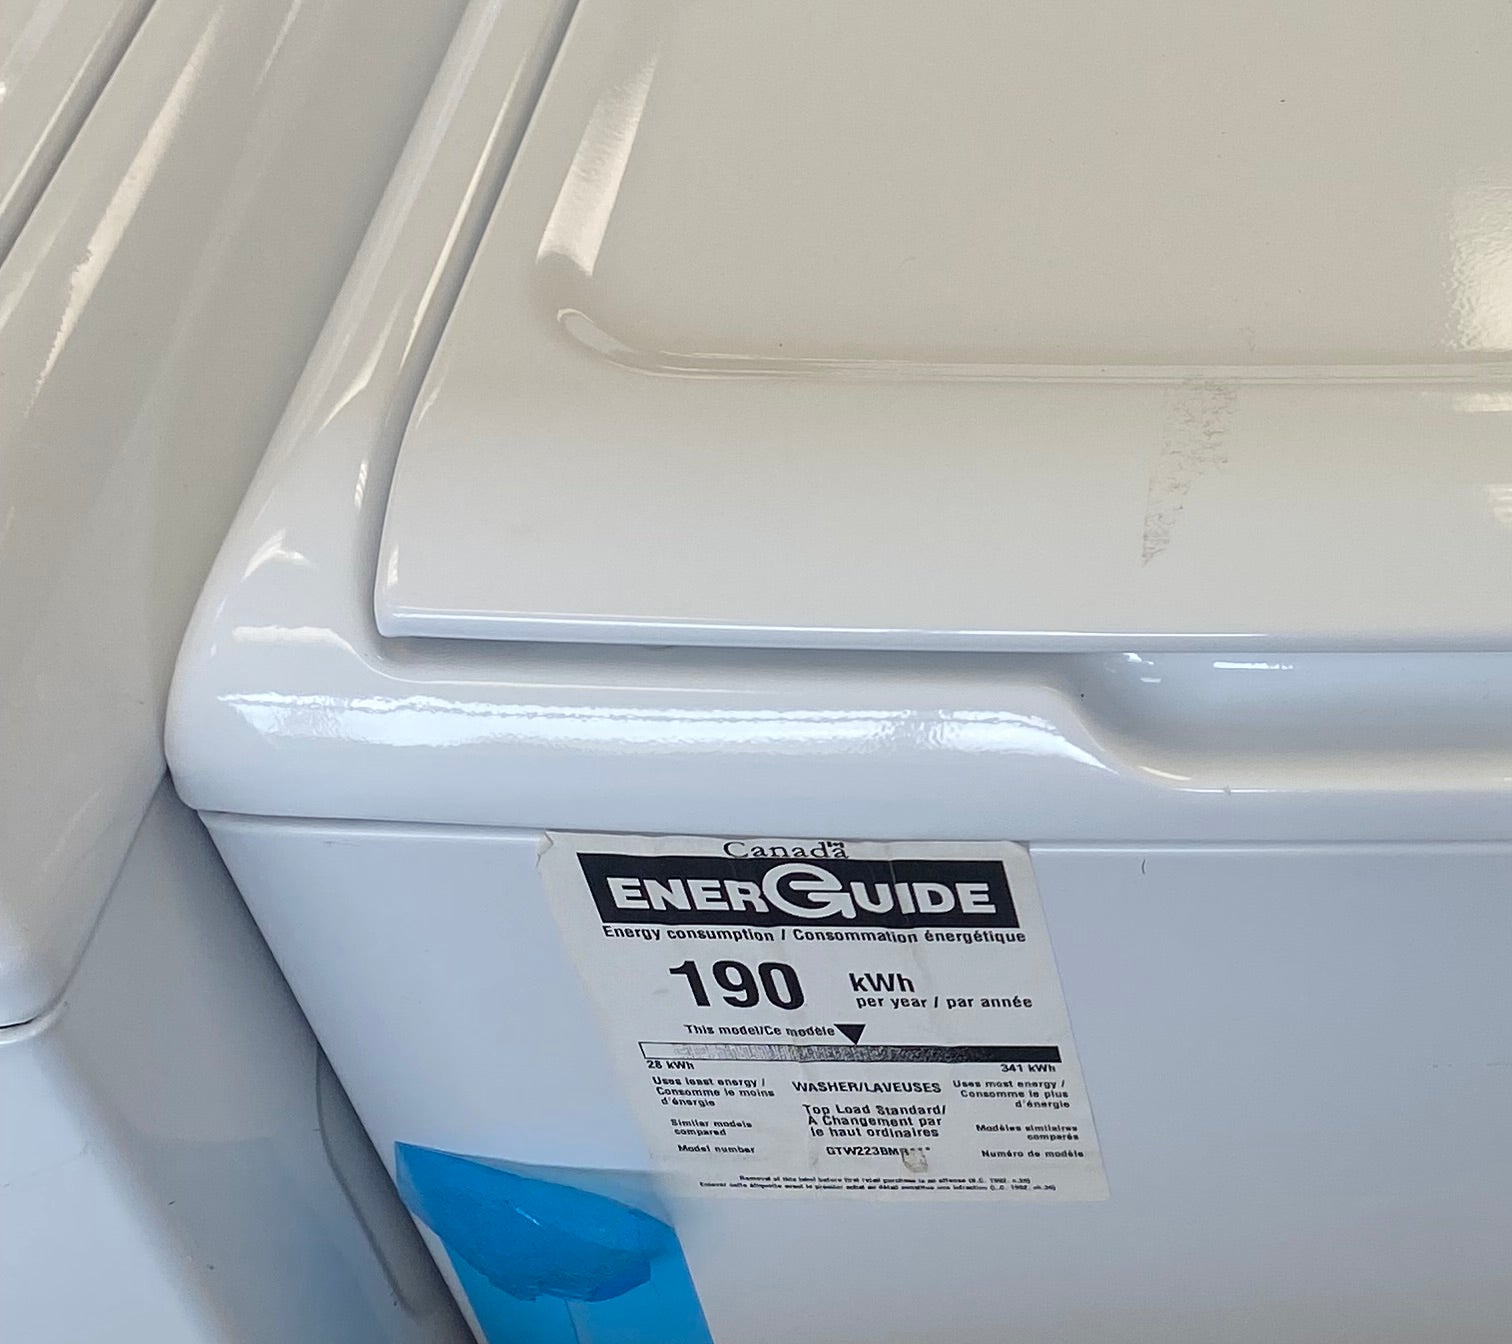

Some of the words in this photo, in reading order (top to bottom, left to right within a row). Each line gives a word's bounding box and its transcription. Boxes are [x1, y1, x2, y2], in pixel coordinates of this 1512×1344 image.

[723, 841, 849, 859] Canada
[606, 863, 997, 919] ENERGUIDE
[603, 925, 661, 941] Energy
[667, 927, 775, 943] consumption
[793, 928, 918, 944] Consommation
[925, 928, 1027, 944] énergétique
[669, 959, 805, 1011] 190
[849, 972, 916, 993] kWh
[856, 997, 883, 1009] per
[890, 997, 928, 1009] year
[946, 997, 974, 1010] par
[980, 994, 1033, 1008] année
[683, 1024, 715, 1035] This
[719, 1025, 782, 1037] model/Ce
[785, 1025, 836, 1038] modèle
[647, 1060, 663, 1069] 28
[667, 1060, 695, 1070] kWh
[1000, 1064, 1024, 1073] 341
[1028, 1063, 1057, 1073] kWh
[652, 1076, 682, 1086] Uses
[685, 1076, 714, 1086] least
[718, 1077, 757, 1088] energy
[792, 1081, 942, 1094] WASHER/LAVEUSES
[952, 1079, 981, 1089] Uses
[985, 1080, 1014, 1089] most
[1017, 1080, 1058, 1090] energy
[656, 1086, 721, 1097] Consomme
[724, 1087, 736, 1097] le
[739, 1088, 776, 1098] moins
[960, 1089, 1025, 1098] Consomme
[1028, 1089, 1041, 1098] le
[1044, 1089, 1069, 1100] plus
[802, 1103, 830, 1117] Top
[837, 1104, 871, 1115] Load
[876, 1104, 947, 1116] Standard/
[670, 1118, 710, 1128] Similar
[714, 1118, 753, 1129] models
[822, 1115, 914, 1128] Changement
[919, 1117, 942, 1130] par
[674, 1128, 727, 1138] compared
[811, 1127, 825, 1138] le
[829, 1127, 862, 1137] haut
[866, 1127, 939, 1139] ordinaires
[678, 1144, 710, 1154] Model
[714, 1145, 756, 1155] number
[980, 1149, 1024, 1158] Numéro
[1028, 1149, 1041, 1158] de
[1044, 1149, 1085, 1158] modèle
